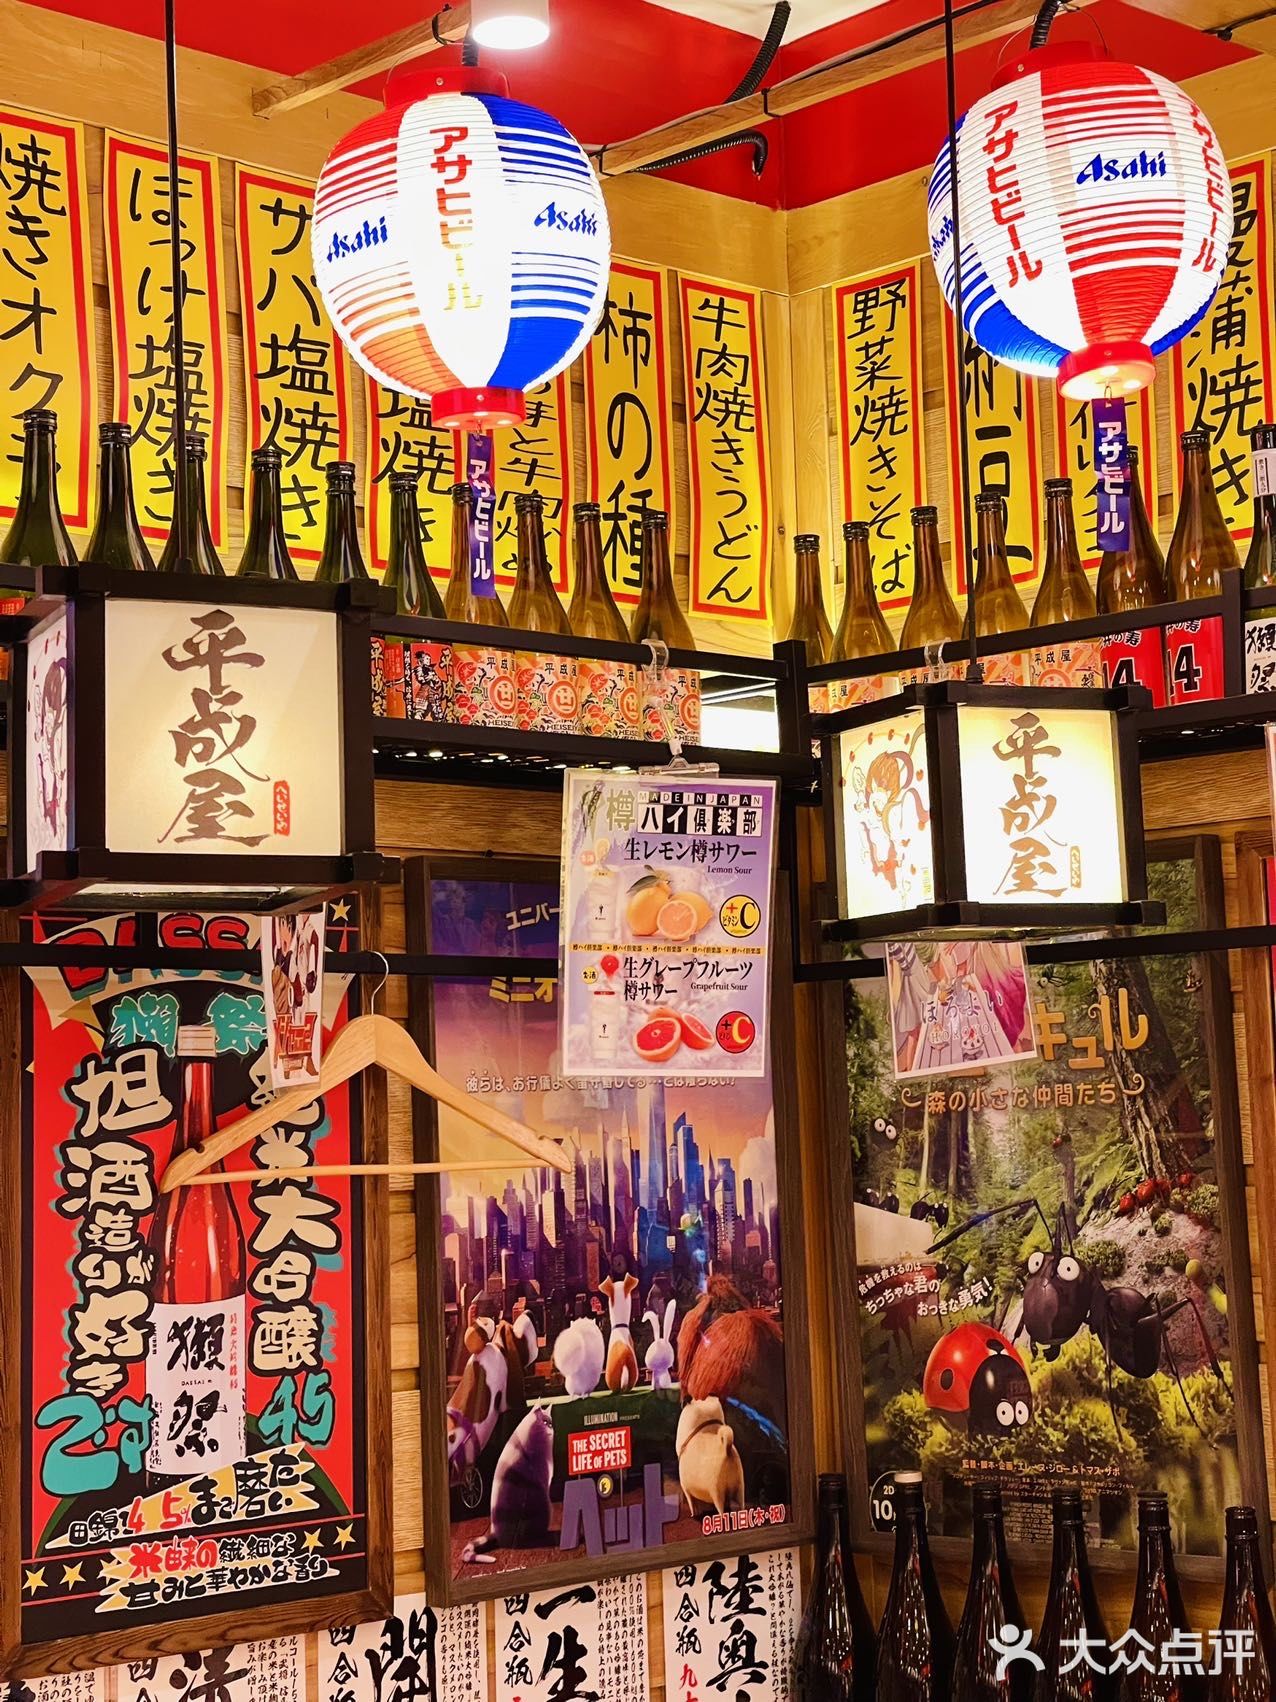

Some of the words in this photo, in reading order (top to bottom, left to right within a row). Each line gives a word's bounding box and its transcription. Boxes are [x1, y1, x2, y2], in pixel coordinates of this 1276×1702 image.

[1076, 150, 1168, 185] Asahi
[983, 100, 1043, 288] アサヒビール
[326, 215, 389, 263] Asahi
[430, 126, 483, 311] アサヒビール
[534, 201, 599, 237] Asahi
[0, 133, 67, 505] 焼きオク
[129, 167, 212, 523] ほっけ塩焼き
[592, 291, 654, 588] 柿の種
[691, 296, 760, 604] 牛肉焼きうどん
[848, 279, 914, 594] 野菜焼きそば
[1098, 421, 1125, 534] アサヒビール
[469, 458, 492, 580] アサヒビール
[157, 608, 271, 849] 平成屋
[992, 711, 1068, 898] 平成屋
[624, 838, 757, 864] 生レモン樽サワー
[707, 865, 733, 874] Lemon
[734, 866, 753, 875] Sour
[623, 956, 754, 981] 生グレープフルーツ
[624, 981, 678, 1002] 樽サワー
[690, 982, 730, 993] Grapefruit
[730, 982, 749, 991] Sour
[921, 989, 1004, 1024] ほろよい
[927, 1080, 1117, 1115] 森の小さな仲間たち
[865, 1275, 941, 1315] ちっちゃな君の
[572, 1439, 588, 1454] THE
[589, 1430, 626, 1451] SECRET
[583, 1411, 618, 1426] ILLUMINATION
[573, 1453, 593, 1472] LIFE
[603, 1449, 628, 1468] PETS
[883, 1485, 895, 1495] 2D
[674, 1564, 702, 1657] 四合瓶
[701, 1555, 769, 1702] 陸奥
[503, 1592, 533, 1688] 四合瓶
